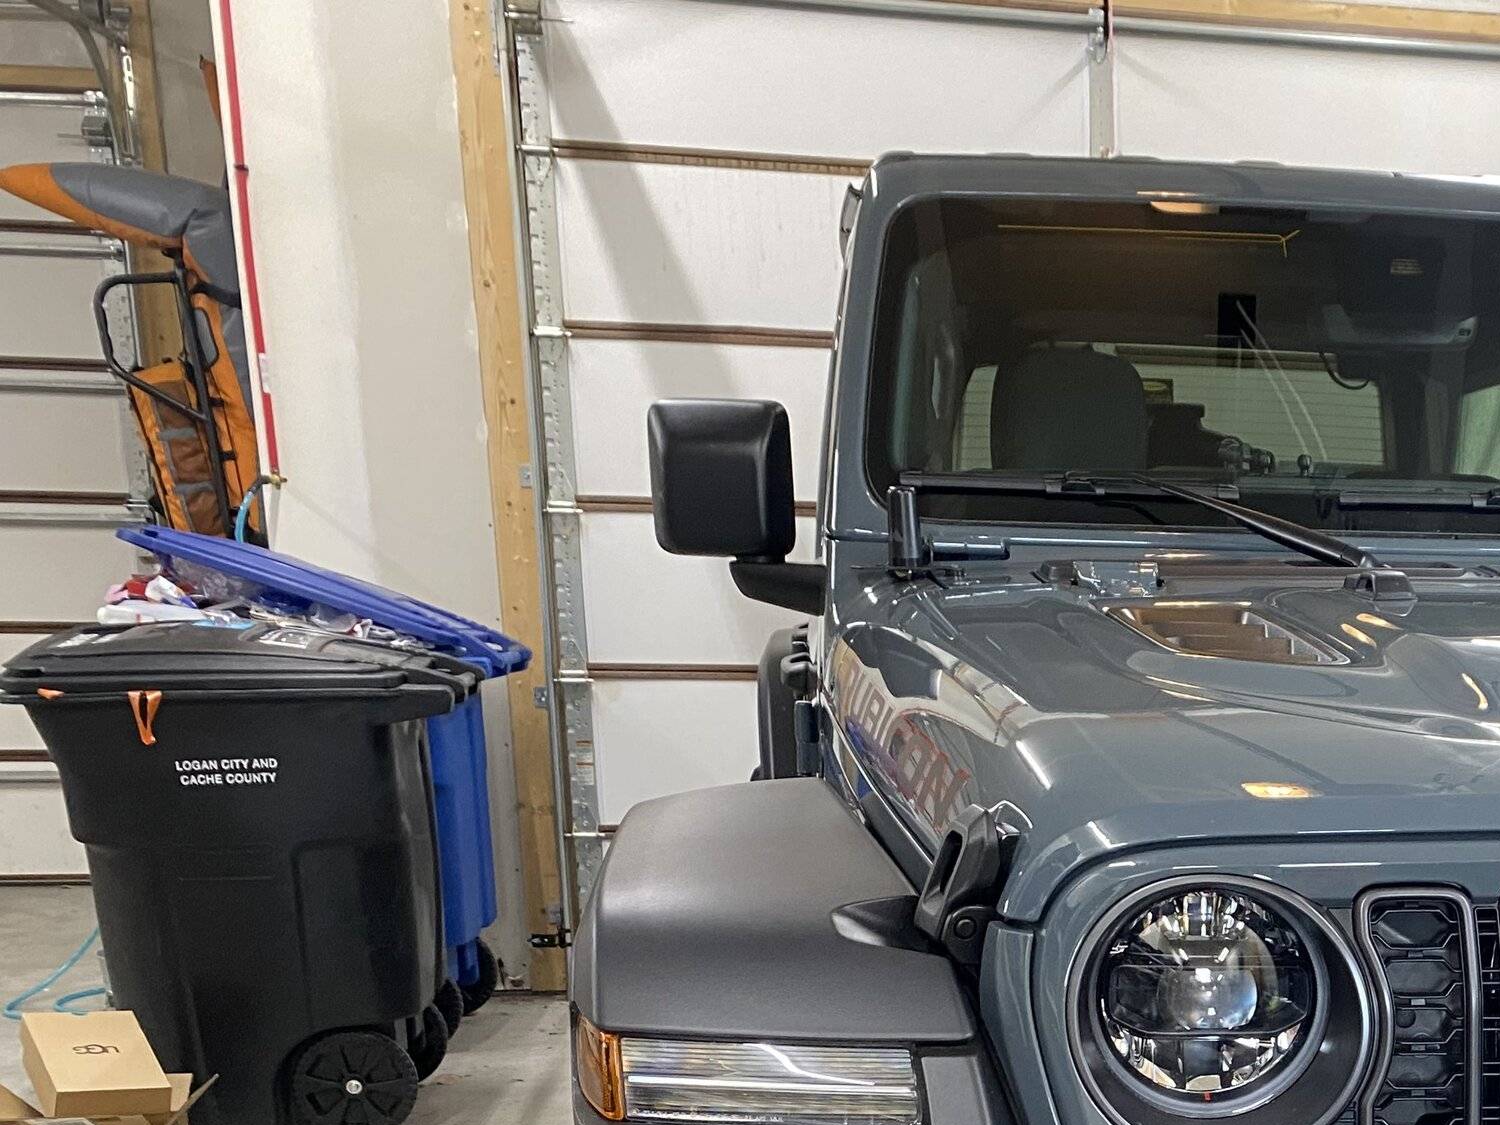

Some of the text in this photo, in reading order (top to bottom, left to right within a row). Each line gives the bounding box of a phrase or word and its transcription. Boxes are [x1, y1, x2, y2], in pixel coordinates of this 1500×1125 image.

[174, 758, 278, 771] LOGAN CITY AND
[180, 772, 276, 785] CACHE COUNTY
